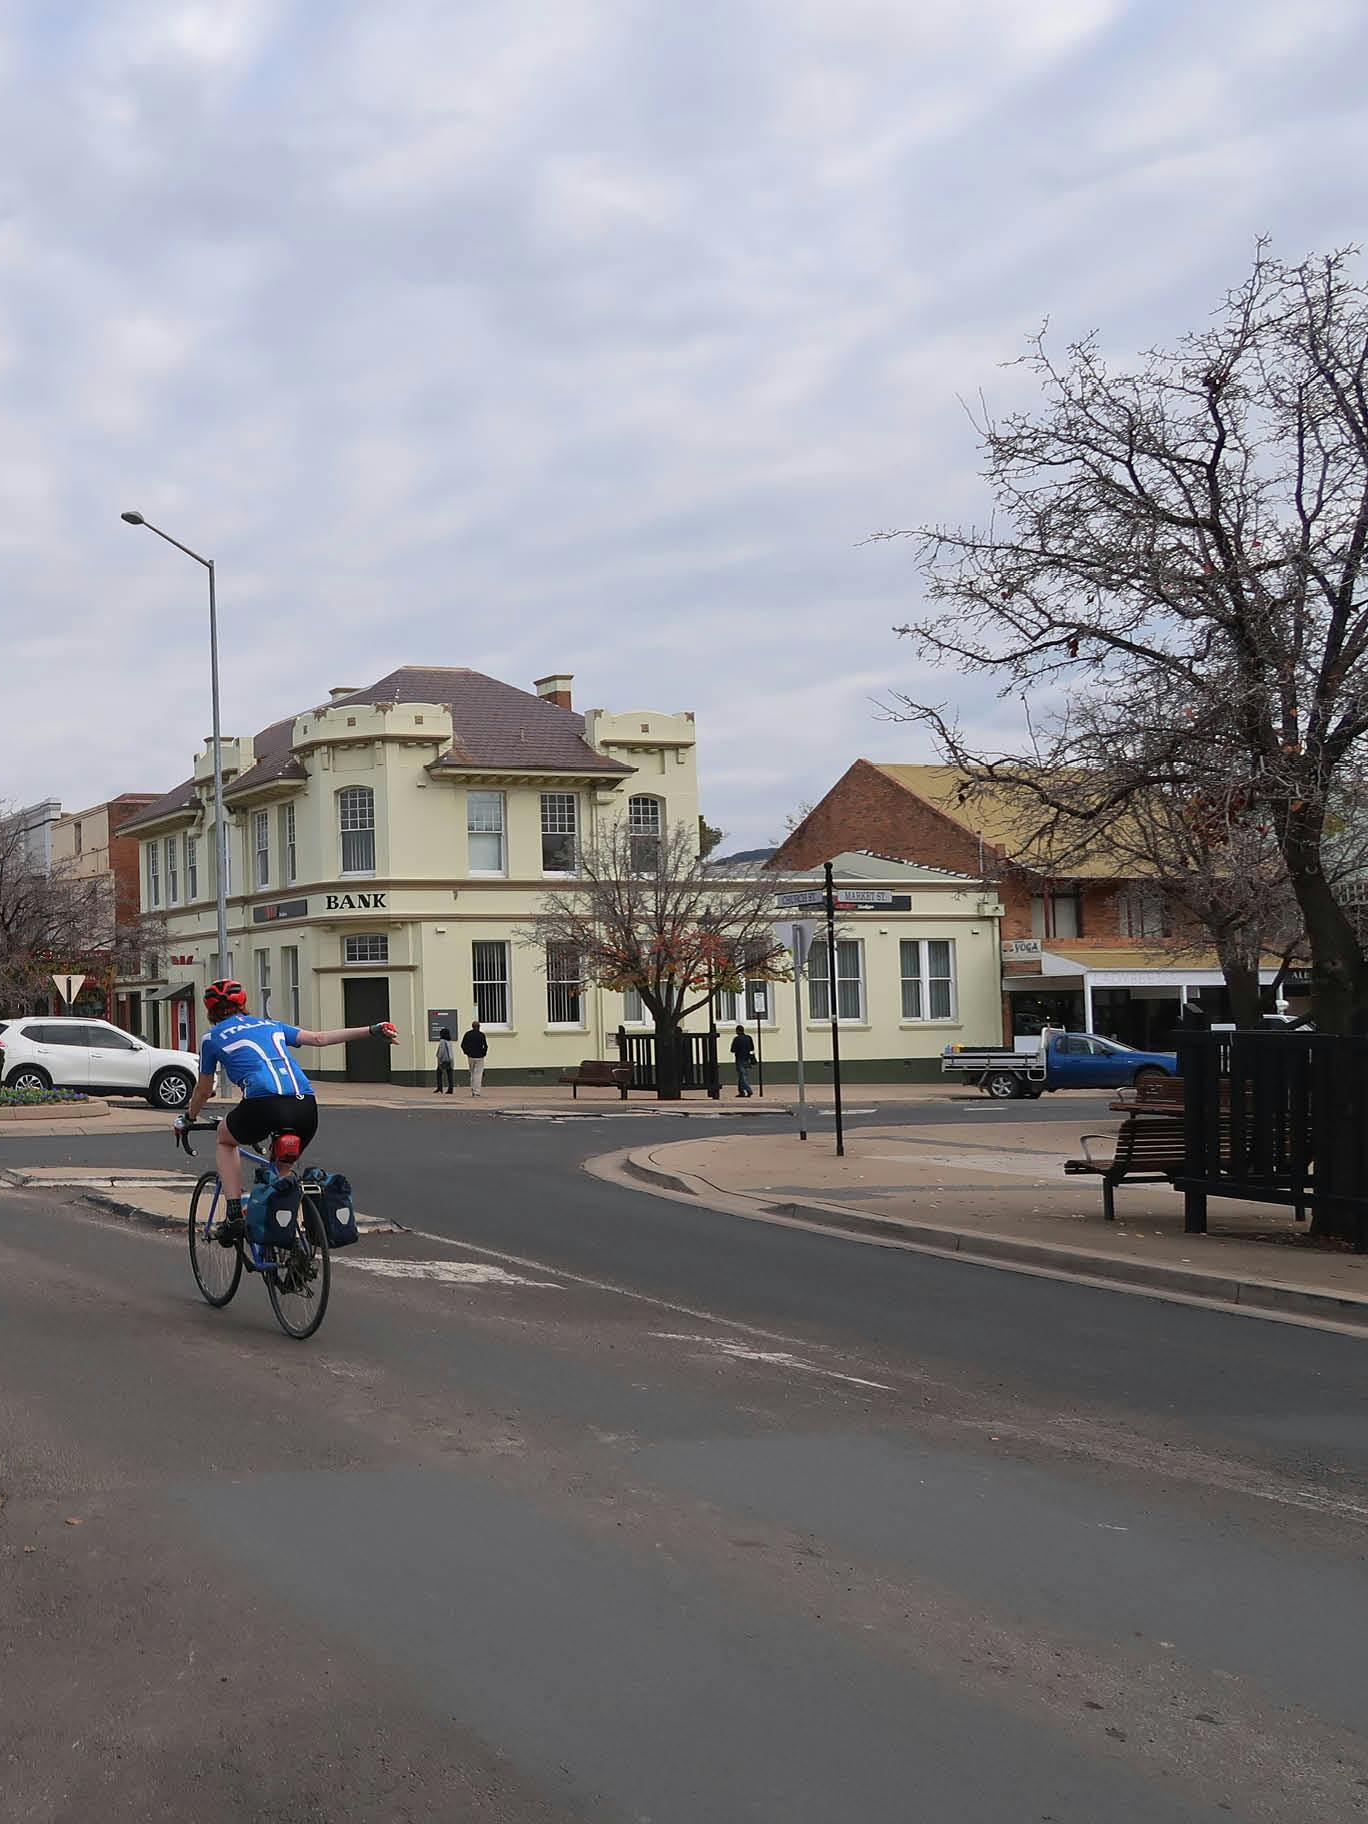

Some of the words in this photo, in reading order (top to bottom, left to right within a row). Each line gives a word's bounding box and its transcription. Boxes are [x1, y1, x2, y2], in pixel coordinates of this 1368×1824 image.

[326, 893, 387, 910] BANK
[844, 891, 874, 901] MARKET
[1014, 942, 1039, 953] YOGA
